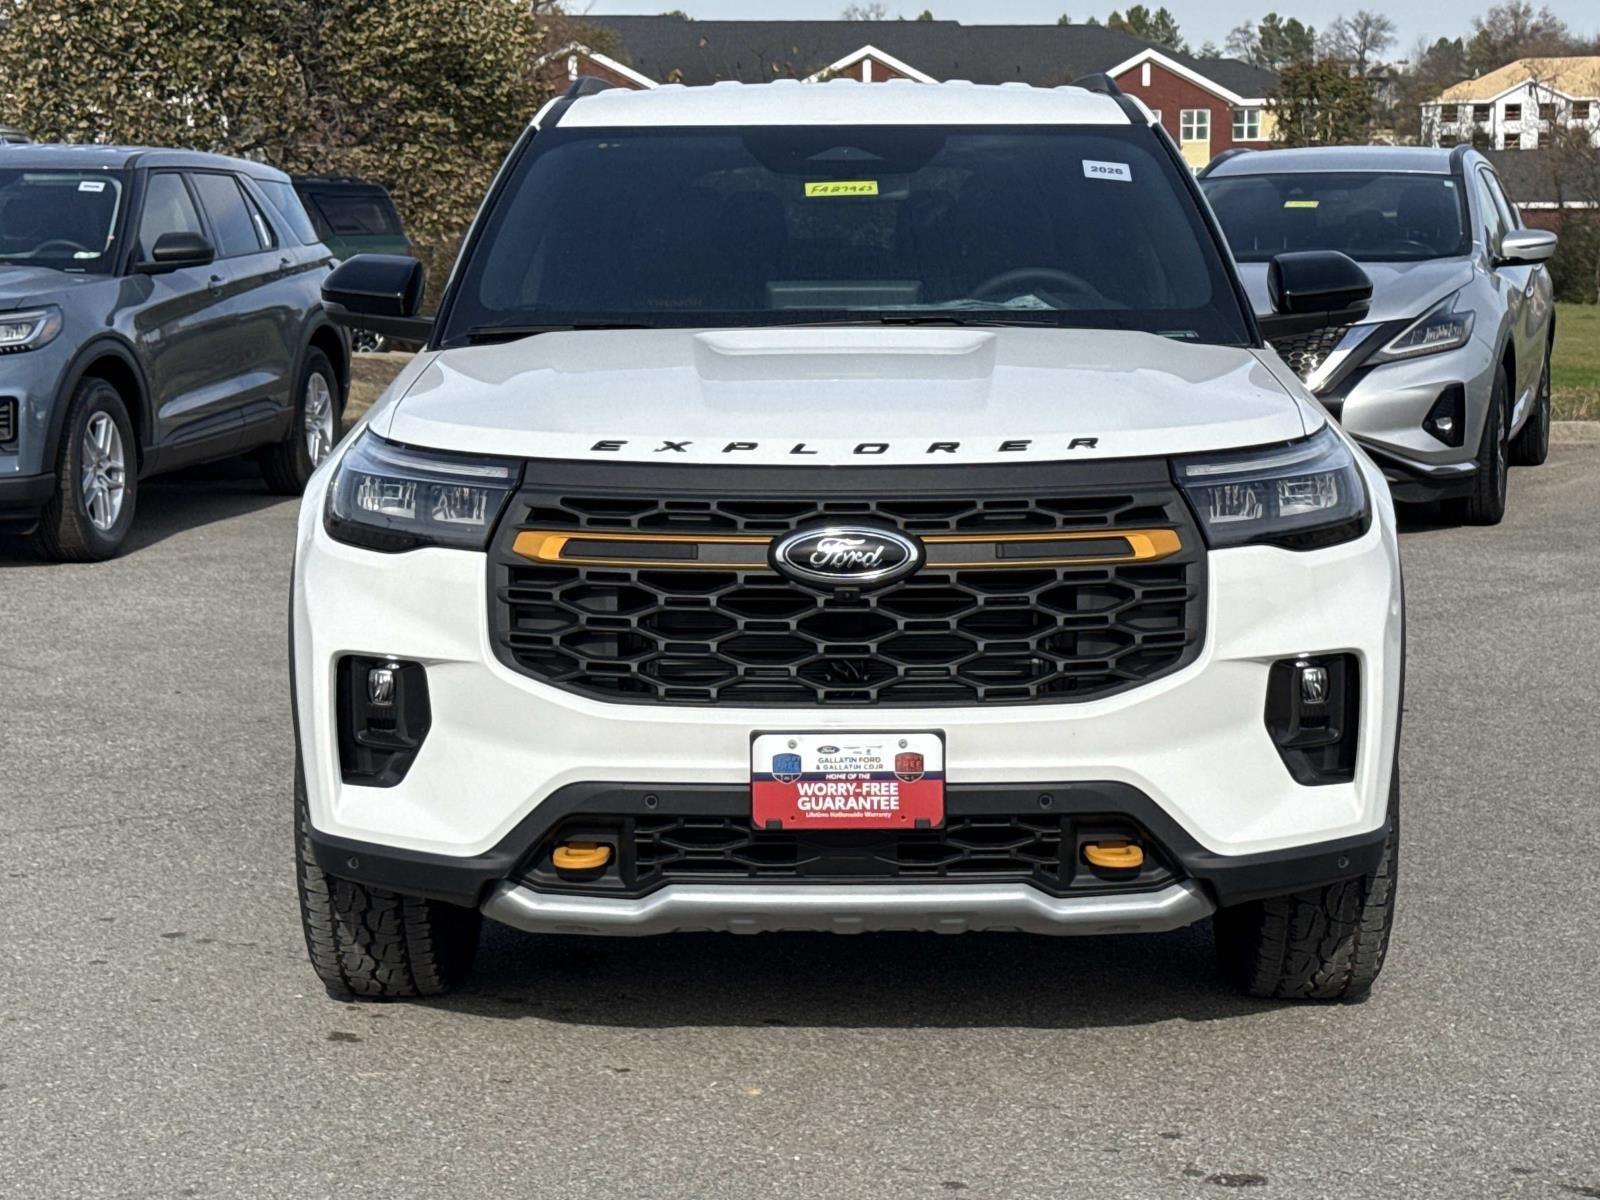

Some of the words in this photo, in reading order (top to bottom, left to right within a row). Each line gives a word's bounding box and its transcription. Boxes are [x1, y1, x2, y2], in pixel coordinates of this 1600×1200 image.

[1090, 166, 1124, 175] 2026
[590, 437, 1100, 455] EXPLORER
[810, 537, 885, 568] Ford
[797, 782, 899, 796] WORRY-FREE
[797, 796, 900, 810] GUARANTEE
